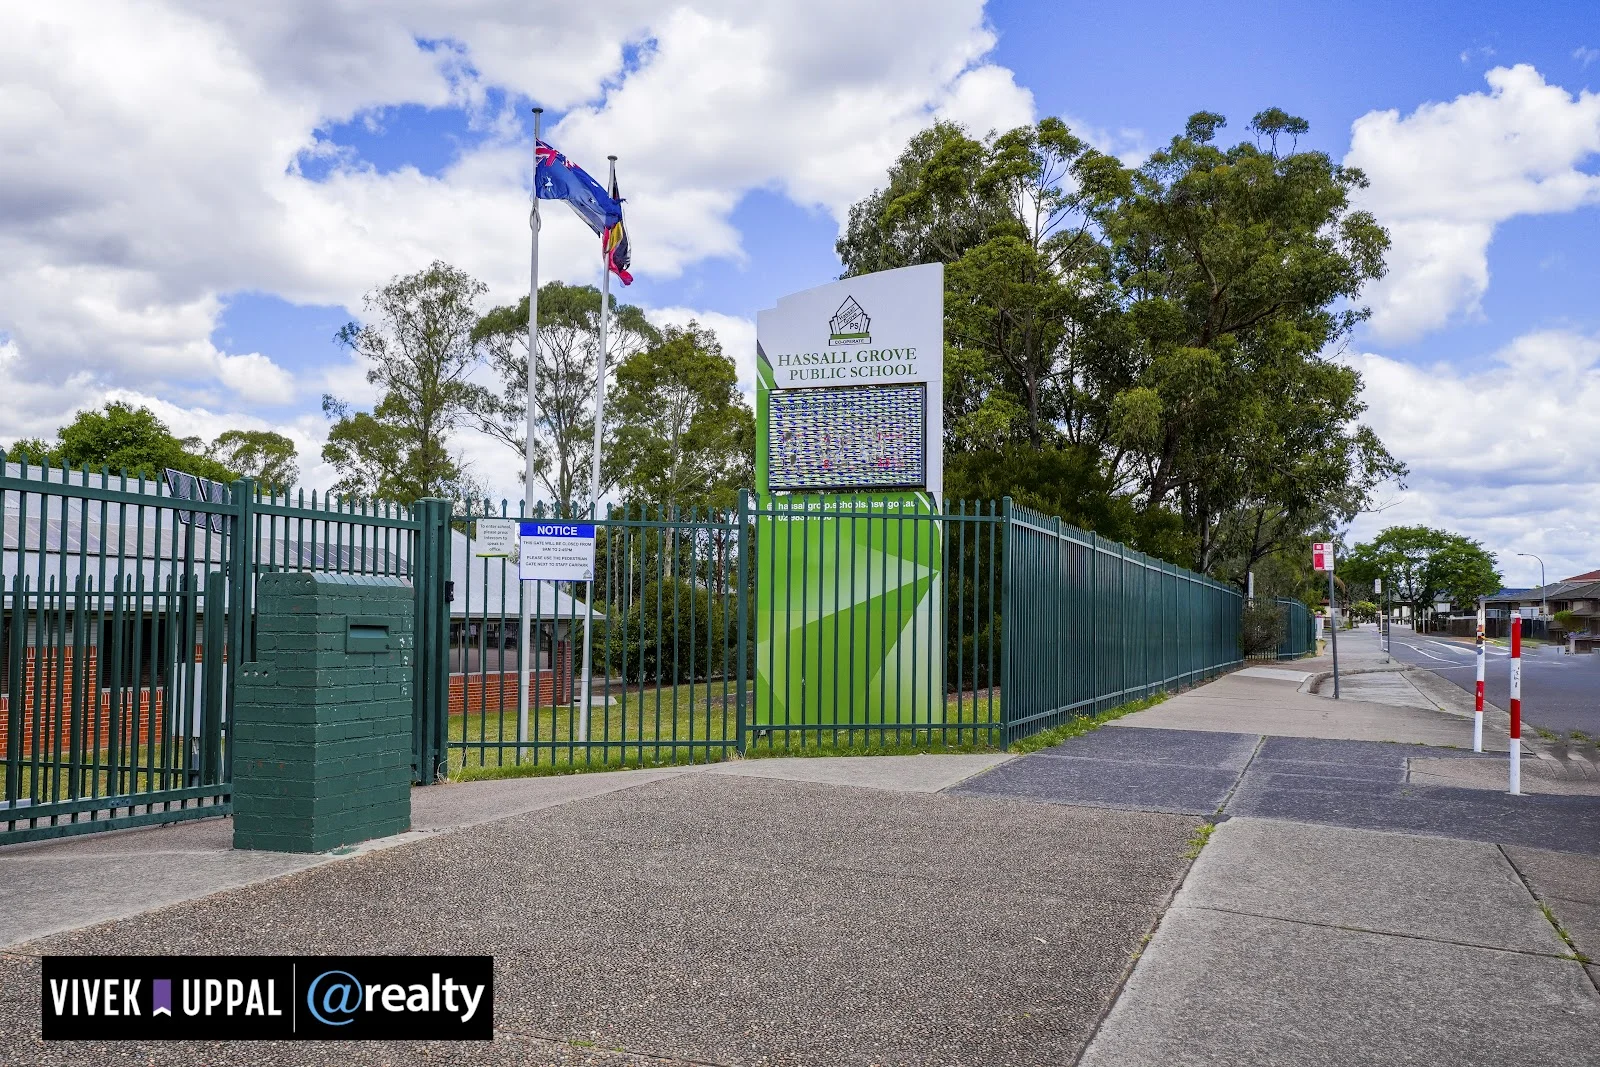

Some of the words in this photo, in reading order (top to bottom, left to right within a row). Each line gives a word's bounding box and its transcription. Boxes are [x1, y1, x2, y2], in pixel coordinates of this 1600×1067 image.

[778, 352, 851, 366] HASSALL
[856, 348, 917, 363] GROVE
[790, 366, 845, 380] PUBLIC
[851, 364, 917, 378] SCHOOL
[537, 526, 578, 536] NOTICE
